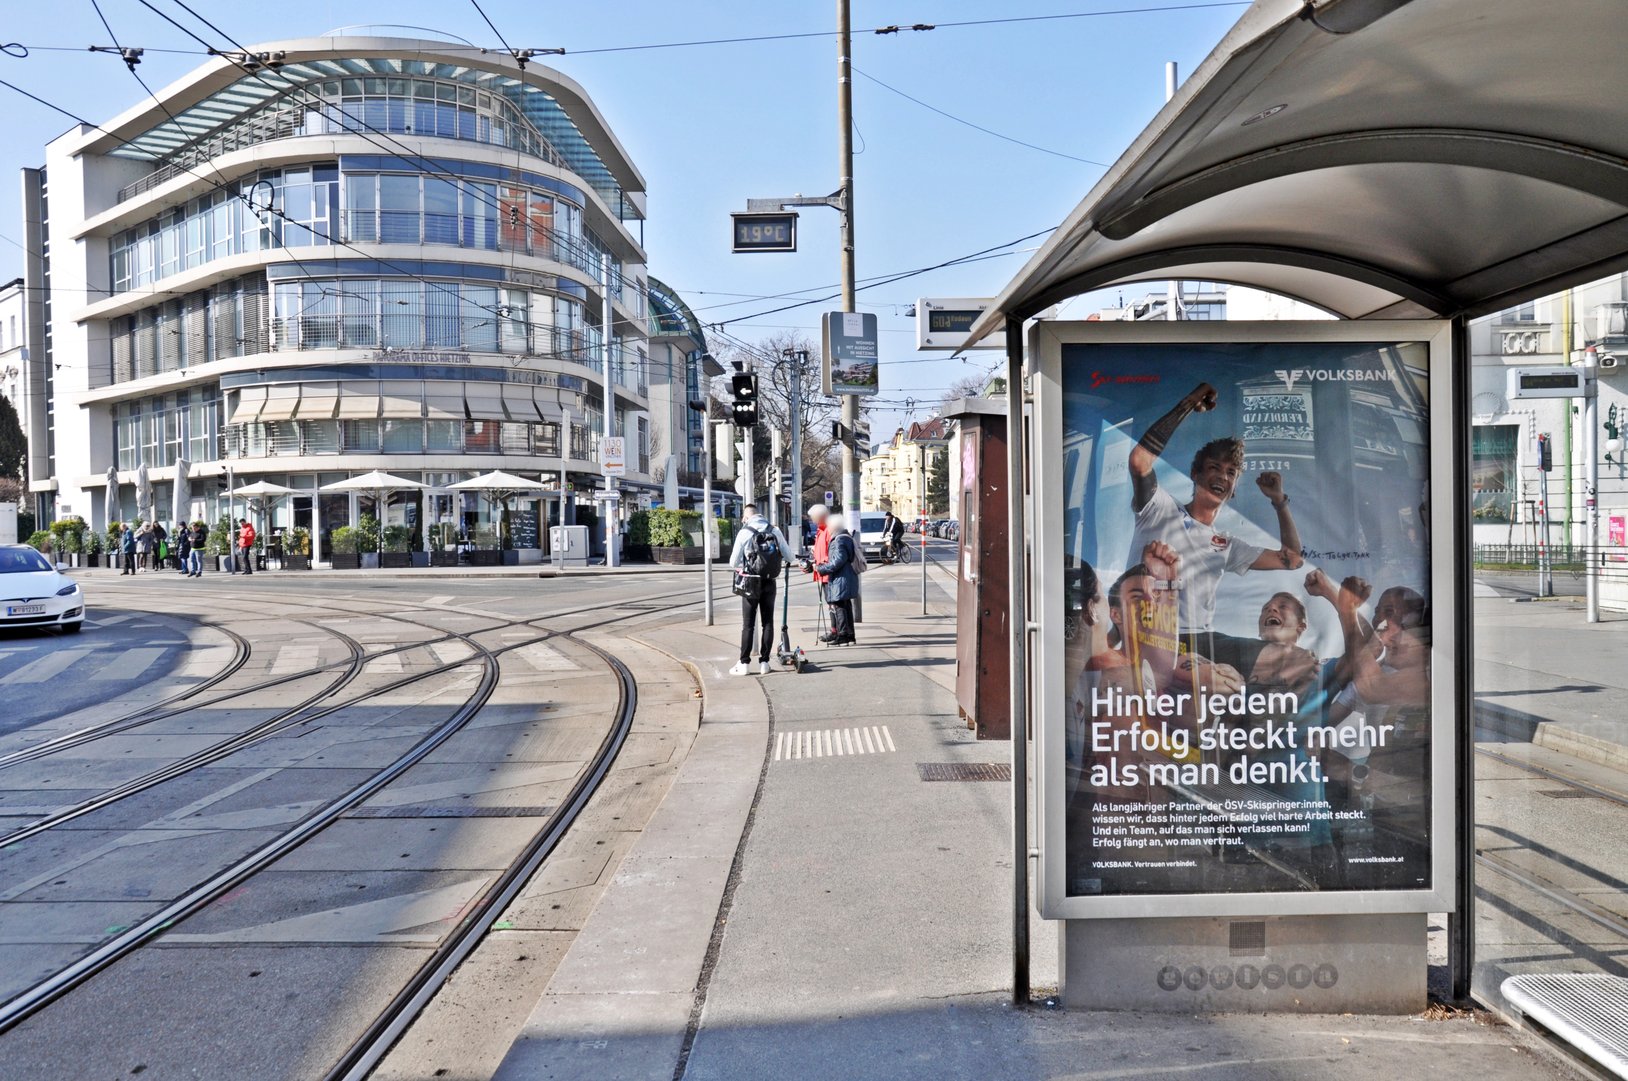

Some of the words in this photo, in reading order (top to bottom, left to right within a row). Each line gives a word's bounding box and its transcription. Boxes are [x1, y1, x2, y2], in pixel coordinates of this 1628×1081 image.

[412, 352, 439, 363] OFFICES
[440, 353, 471, 364] HIETZING
[1306, 370, 1397, 381] VOLKSBANK
[1091, 686, 1193, 718] Hinter
[1198, 686, 1298, 724] jedem
[1092, 720, 1190, 758] Erfolg
[1198, 720, 1298, 751] steckt
[1308, 718, 1394, 749] mehr
[1091, 755, 1139, 787] als
[1148, 762, 1219, 786] man
[1230, 754, 1329, 785] denkt.
[1092, 802, 1108, 812] Als
[1110, 802, 1167, 814] langjähriger
[1169, 802, 1206, 811] Partner
[1206, 801, 1222, 811] der
[1225, 799, 1332, 812] ÖSV-Skispringer:innen,
[1092, 814, 1125, 824] wissen
[1127, 814, 1144, 824] wir,
[1146, 814, 1167, 823] dass
[1169, 813, 1196, 823] hinter
[1198, 813, 1228, 824] jedem
[1230, 812, 1258, 823] Erfolg
[1260, 812, 1276, 821] viel
[1278, 811, 1303, 821] harte
[1304, 810, 1333, 820] Arbeit
[1335, 810, 1366, 819] steckt.
[1092, 826, 1111, 835] Und
[1113, 826, 1127, 835] ein
[1129, 825, 1157, 836] Team,
[1159, 825, 1174, 834] auf
[1176, 825, 1192, 834] das
[1217, 824, 1235, 834] sich
[1237, 824, 1283, 833] verlassen
[1284, 823, 1310, 832] kann!
[1092, 838, 1121, 849] Erfolg
[1123, 837, 1148, 848] fängt
[1149, 838, 1163, 847] an,
[1165, 838, 1179, 846] wo
[1203, 836, 1244, 845] vertraut.
